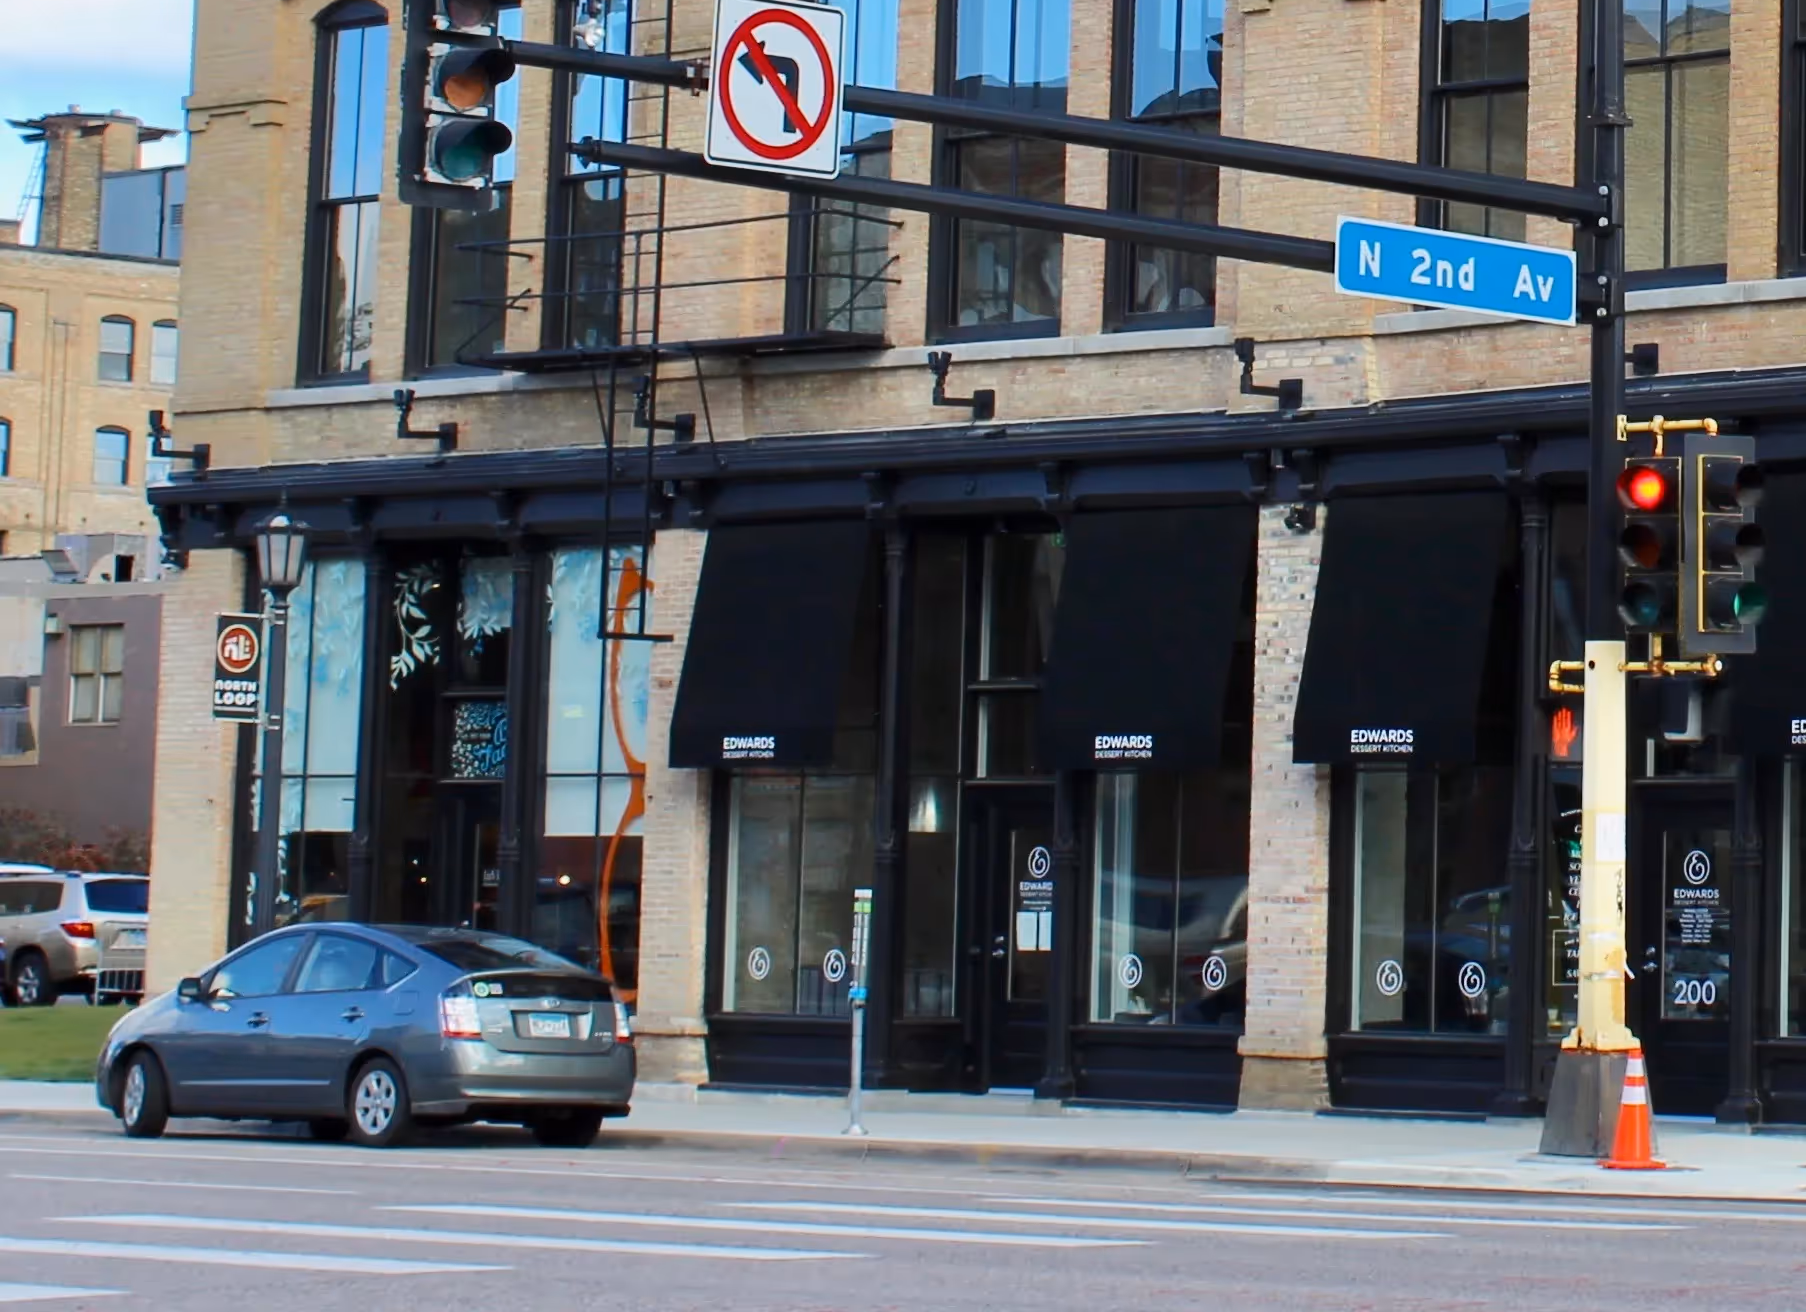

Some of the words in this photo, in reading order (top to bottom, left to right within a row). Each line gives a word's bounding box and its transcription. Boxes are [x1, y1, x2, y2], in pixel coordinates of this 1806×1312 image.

[1359, 240, 1381, 277] N
[1410, 248, 1475, 292] 2nd
[1513, 264, 1554, 302] Av
[214, 691, 257, 706] LOOP
[723, 737, 775, 749] EDWARDS
[1095, 735, 1153, 749] EDWARDS
[1350, 729, 1414, 743] EDWARDS
[1350, 744, 1381, 753] DESSERT
[1019, 881, 1053, 891] EDWARD
[1673, 888, 1720, 899] EDWARDS
[1674, 979, 1716, 1005] 200
